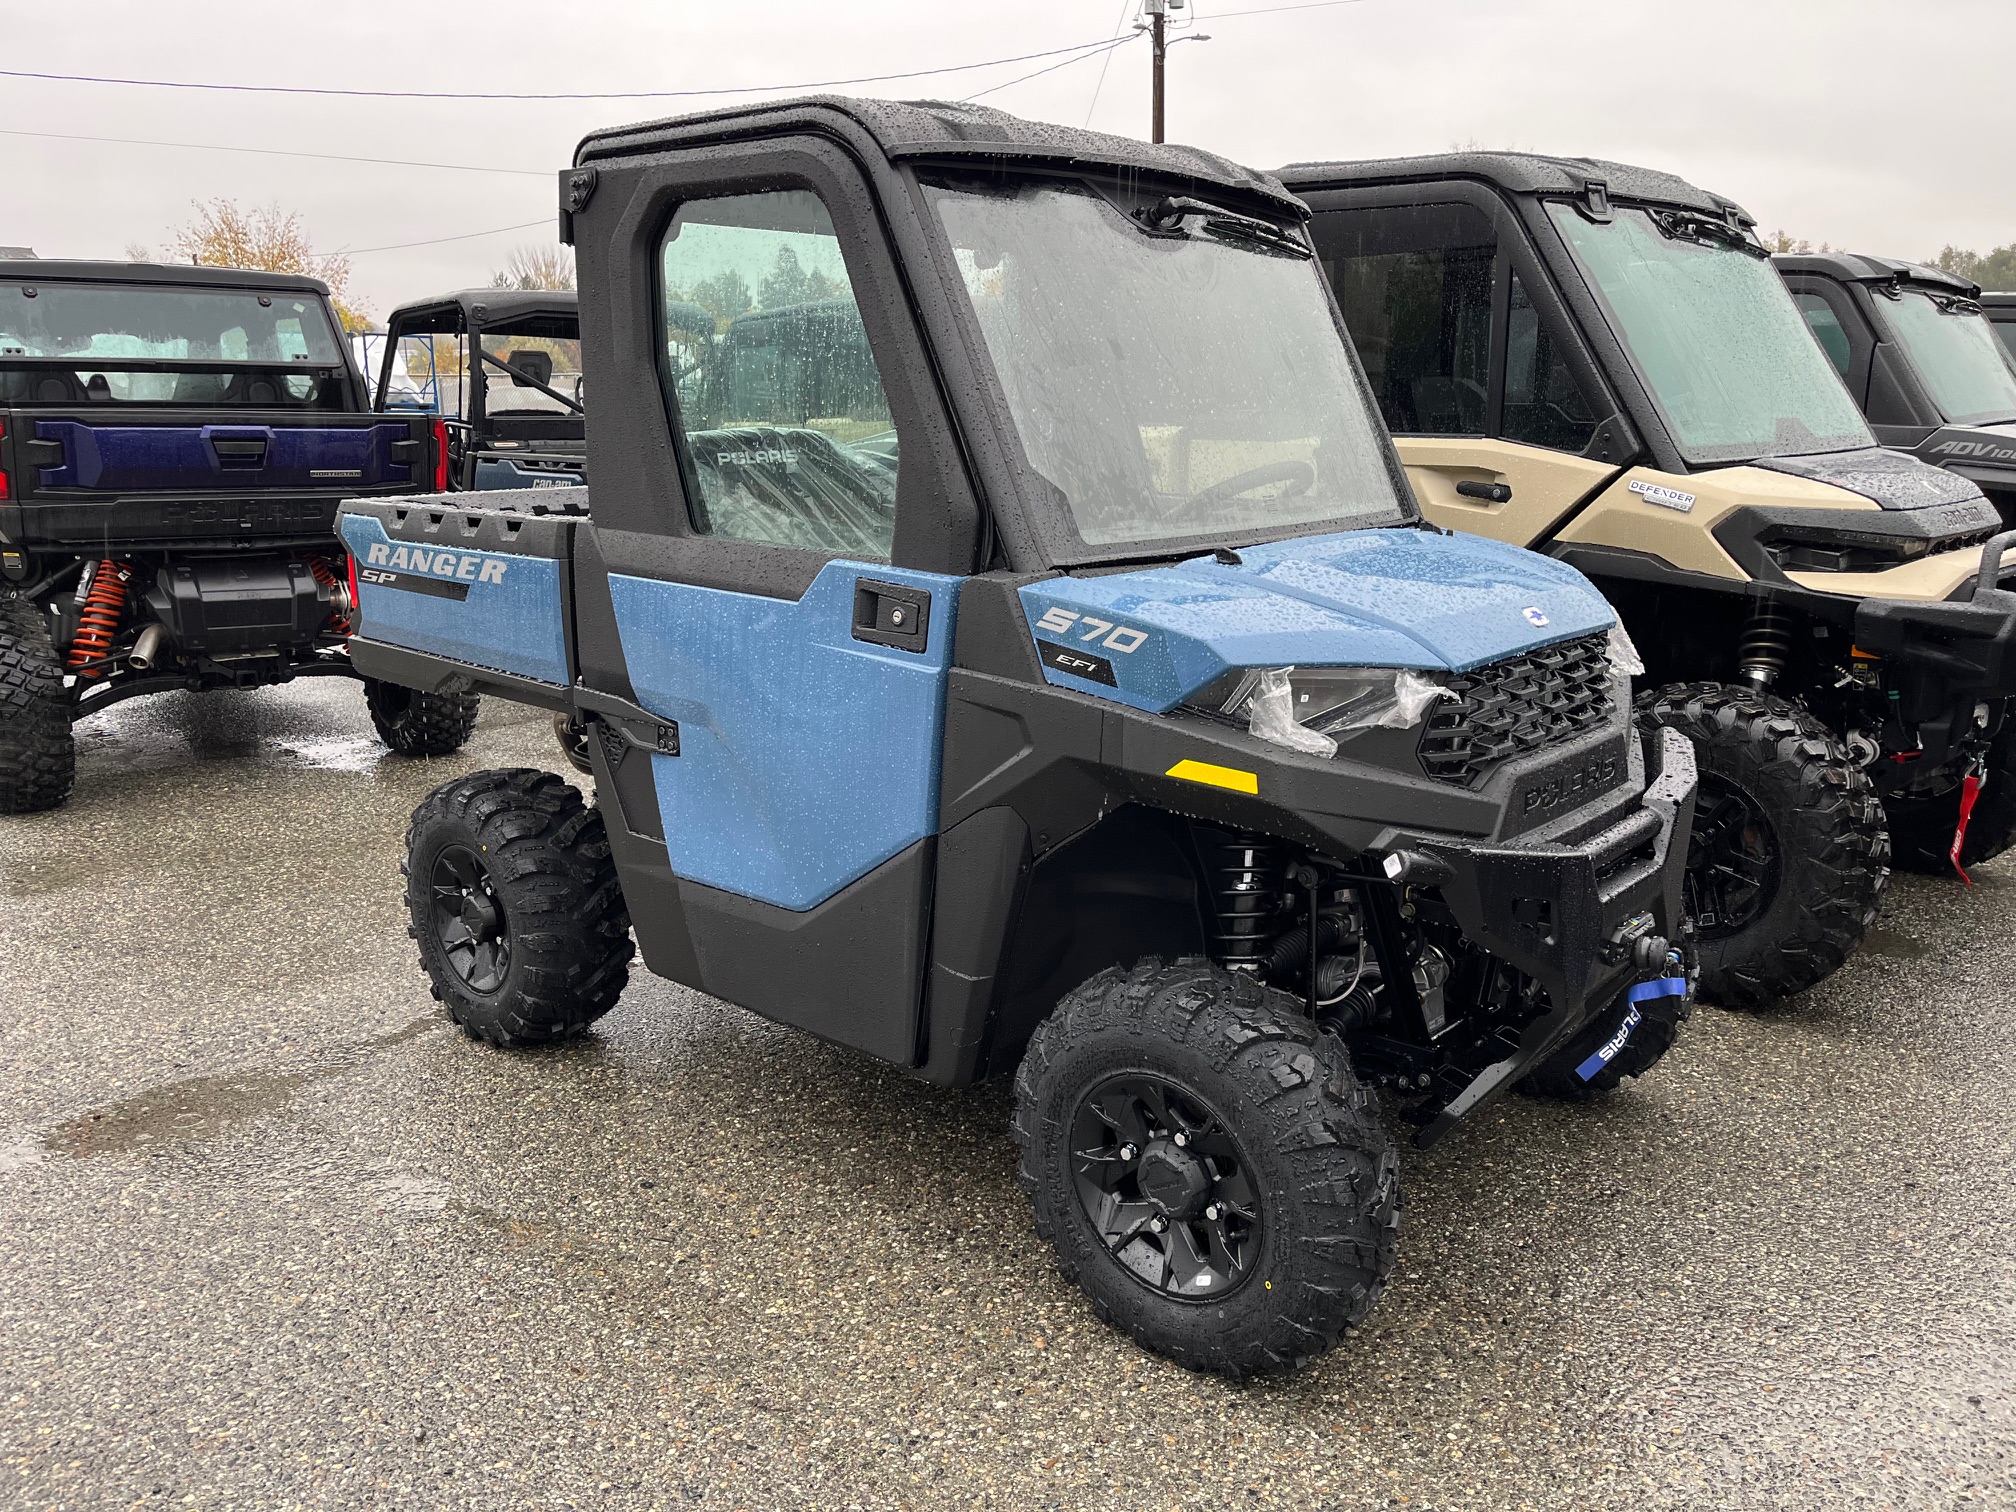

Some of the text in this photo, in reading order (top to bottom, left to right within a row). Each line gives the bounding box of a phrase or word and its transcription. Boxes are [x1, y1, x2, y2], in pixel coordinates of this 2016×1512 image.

[717, 449, 799, 466] POLARIS
[1631, 481, 1693, 503] DEFENDER
[367, 543, 507, 584] RANGER
[360, 569, 397, 583] SP
[1055, 654, 1098, 671] EFI
[1524, 755, 1617, 816] POLARIS
